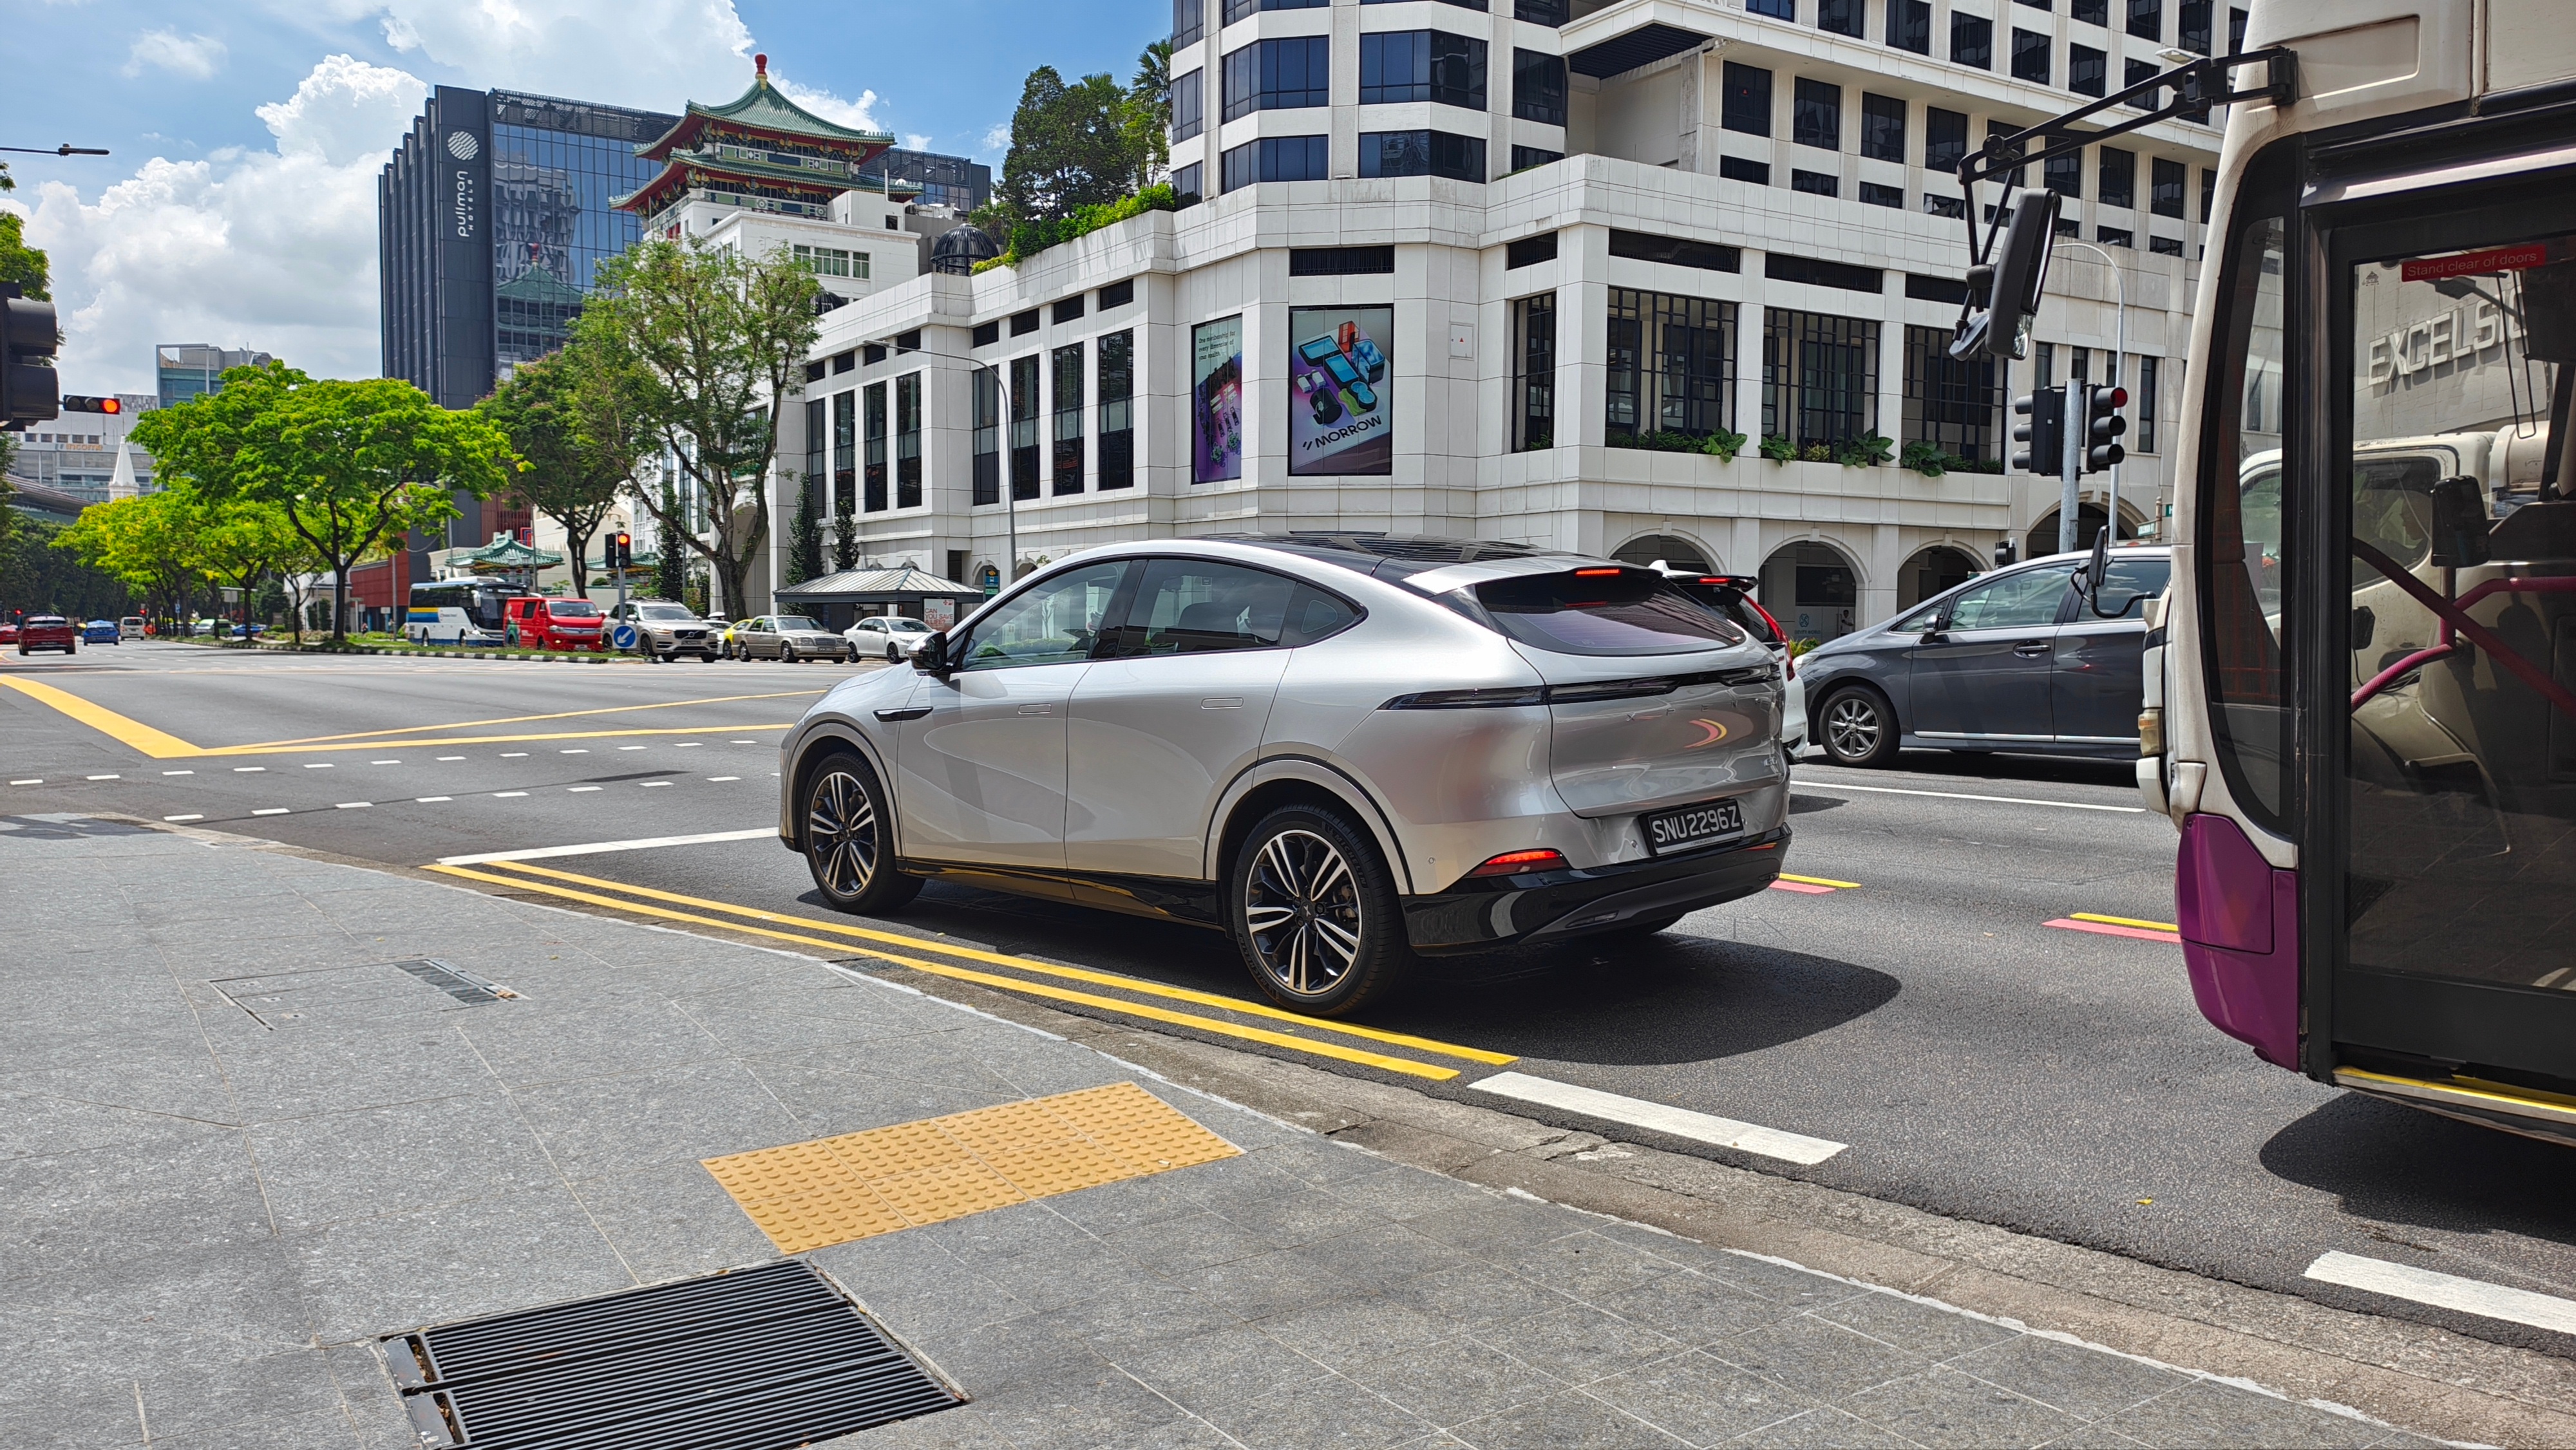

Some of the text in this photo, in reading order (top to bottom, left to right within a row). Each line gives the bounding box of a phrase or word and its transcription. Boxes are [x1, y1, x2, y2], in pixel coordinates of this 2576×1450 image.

[455, 171, 470, 237] pullman
[2407, 252, 2537, 277] Stand clear of doors
[1314, 415, 1382, 448] MORROW
[1651, 805, 1741, 843] SNU2296Z
[1332, 833, 1367, 886] MICHELIN
